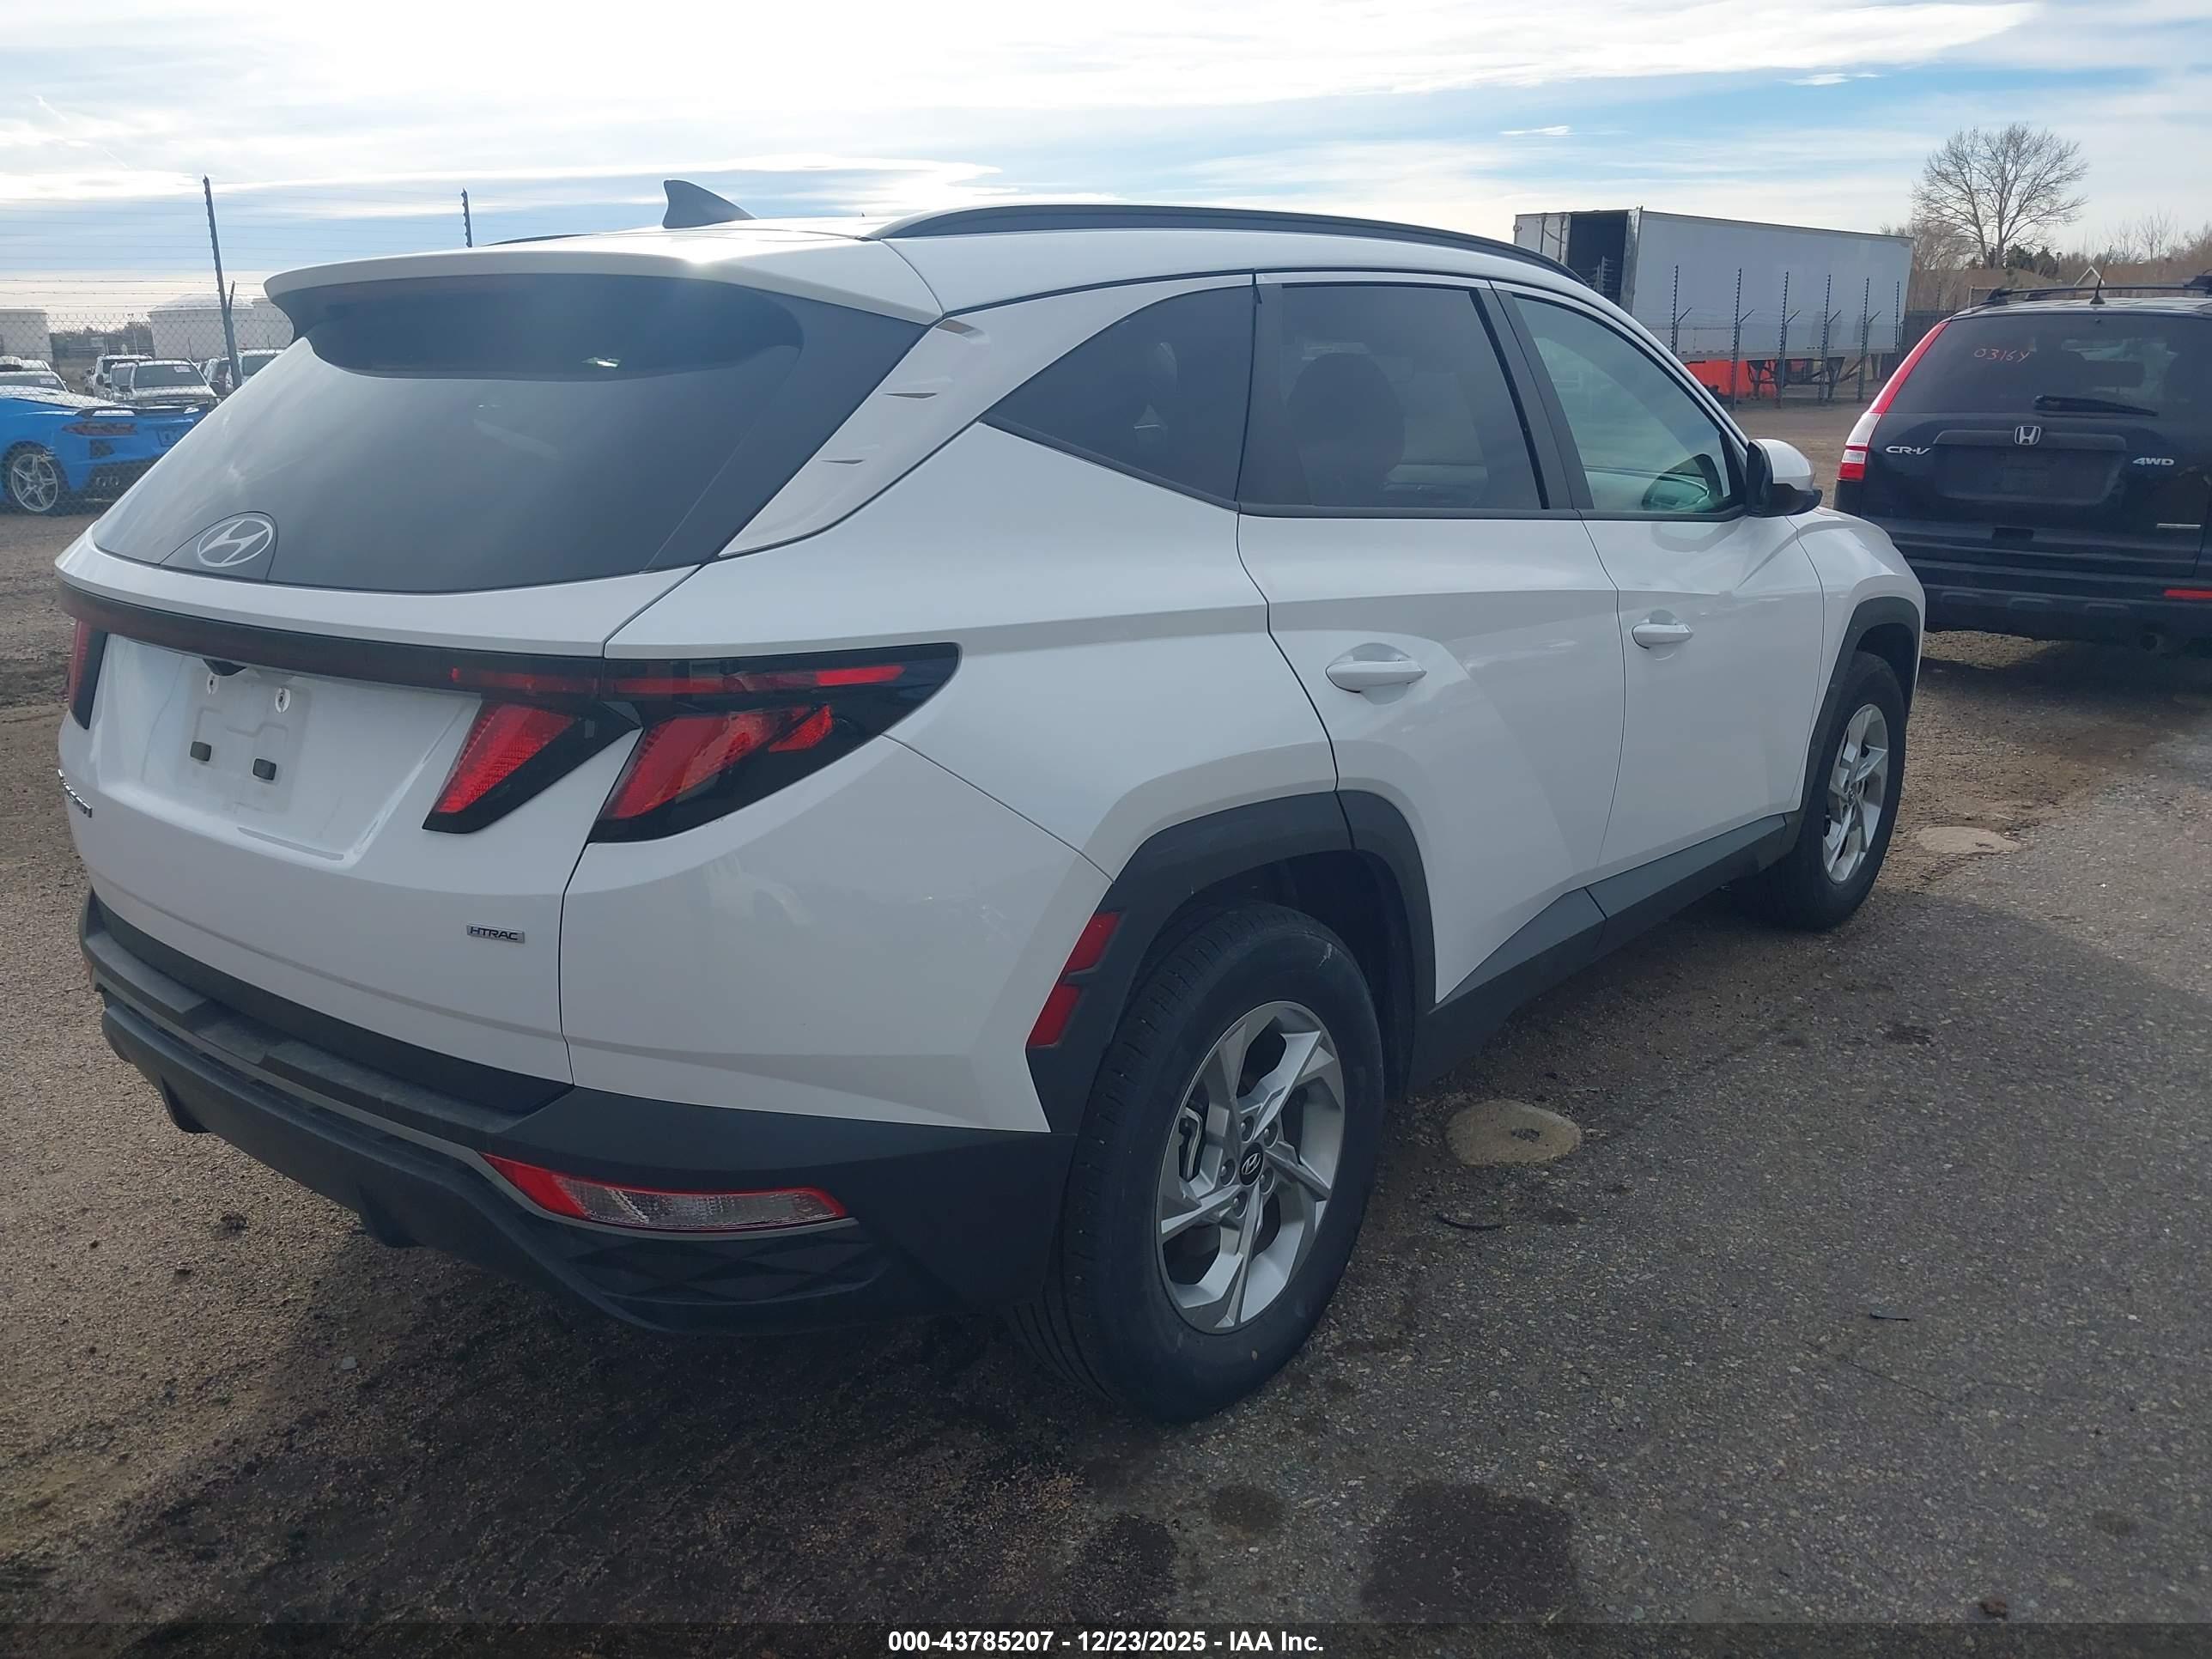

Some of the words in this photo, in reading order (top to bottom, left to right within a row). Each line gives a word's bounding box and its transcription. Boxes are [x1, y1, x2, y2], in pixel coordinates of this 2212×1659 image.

[1885, 446, 1931, 455] CR-V
[2132, 457, 2174, 466] 4WD
[470, 927, 519, 941] HTRAC
